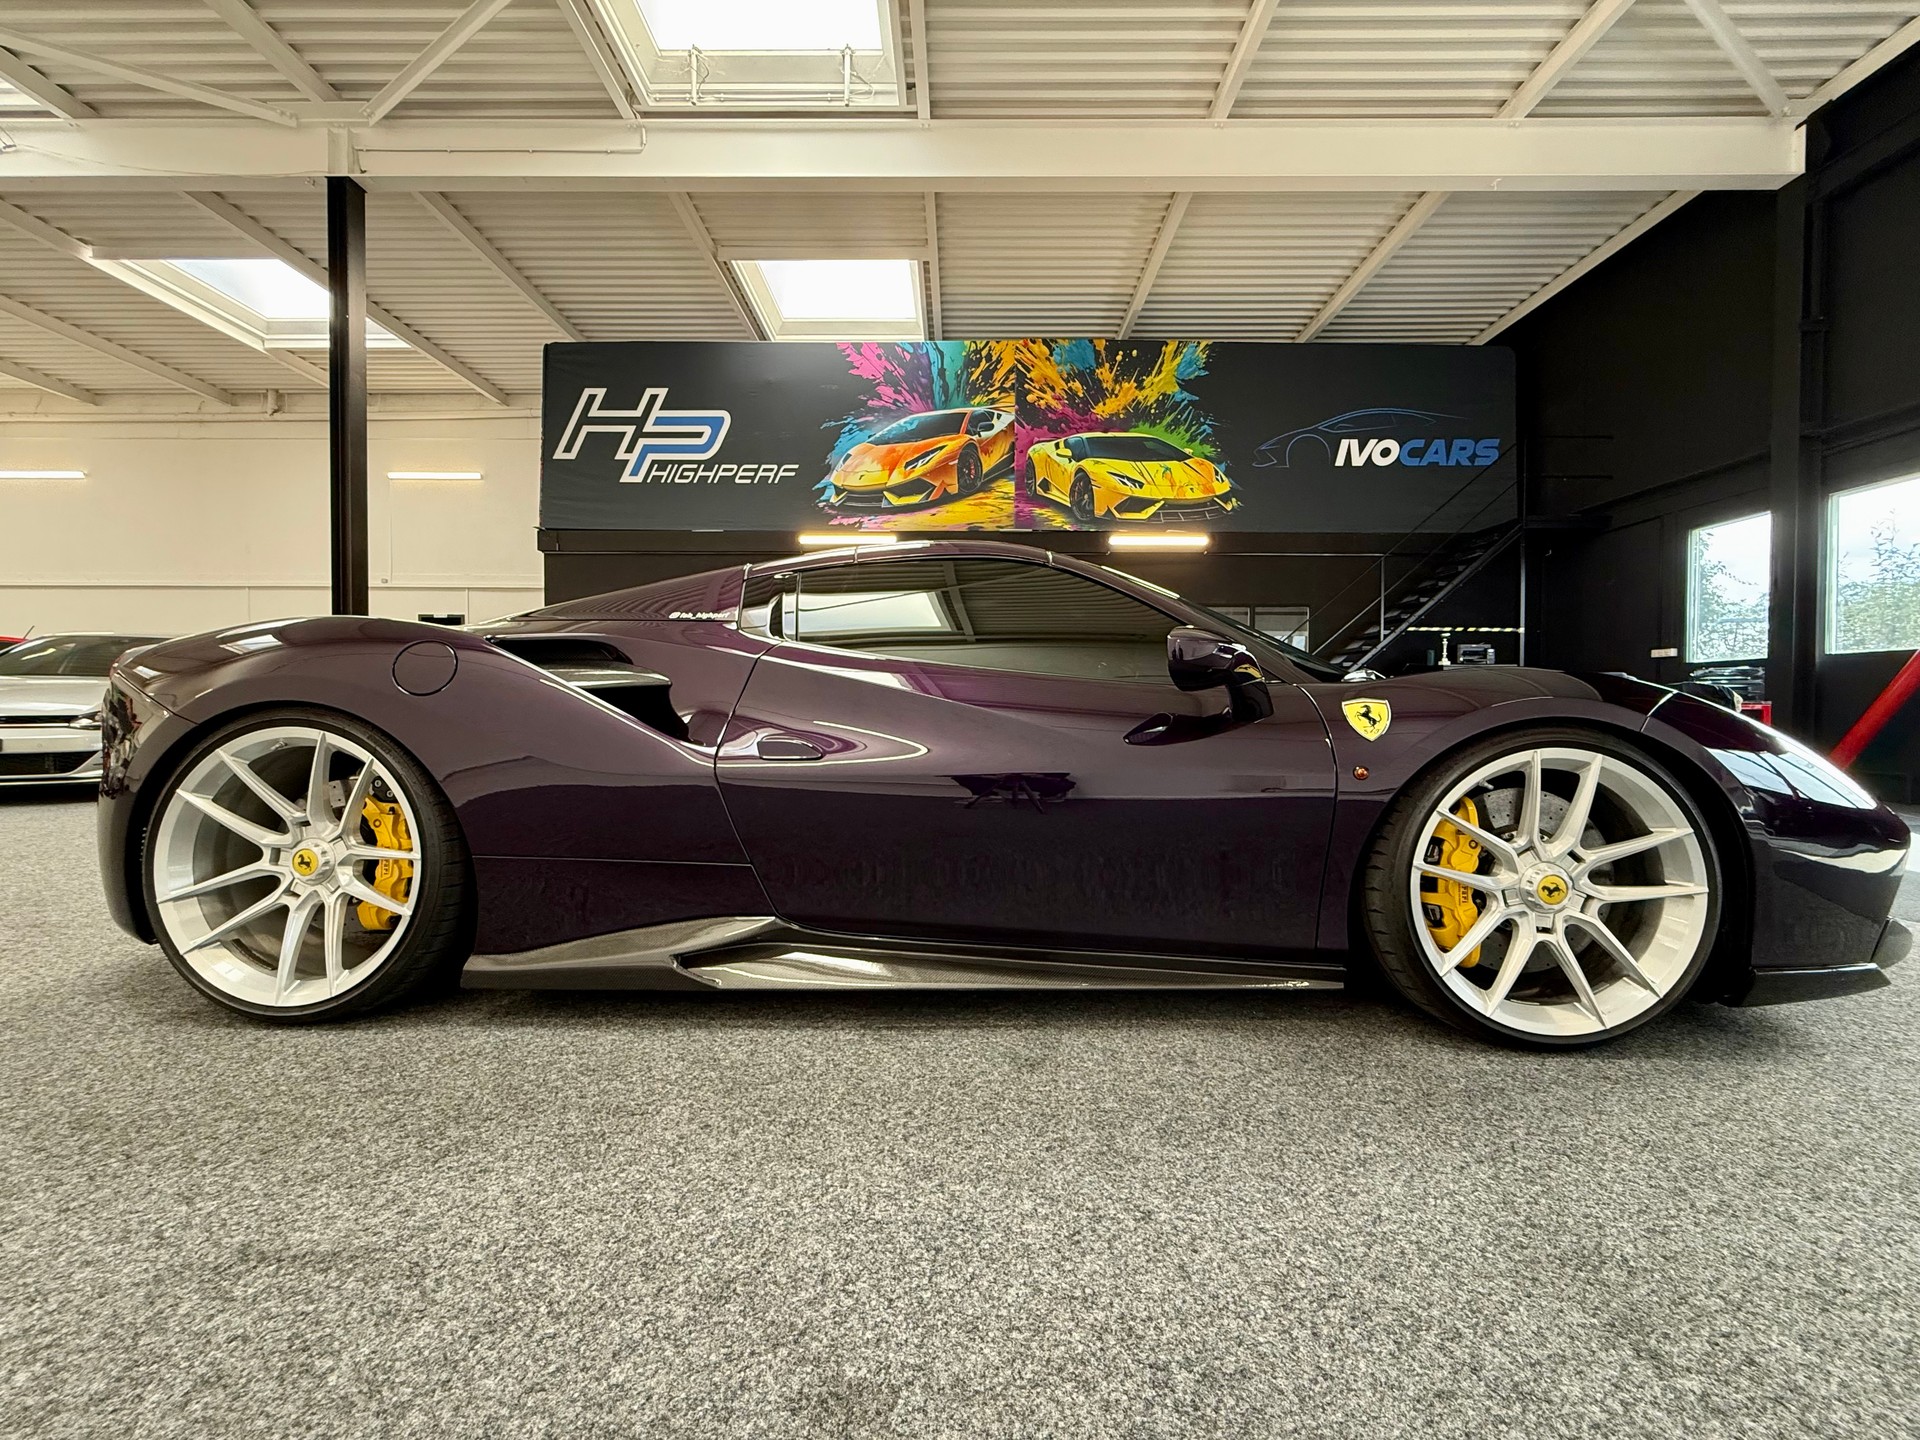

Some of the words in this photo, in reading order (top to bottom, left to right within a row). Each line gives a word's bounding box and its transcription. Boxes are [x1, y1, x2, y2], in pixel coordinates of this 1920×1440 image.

[553, 387, 732, 483] HP
[1334, 438, 1501, 467] IVOCARS
[647, 463, 800, 484] HIGHPERF
